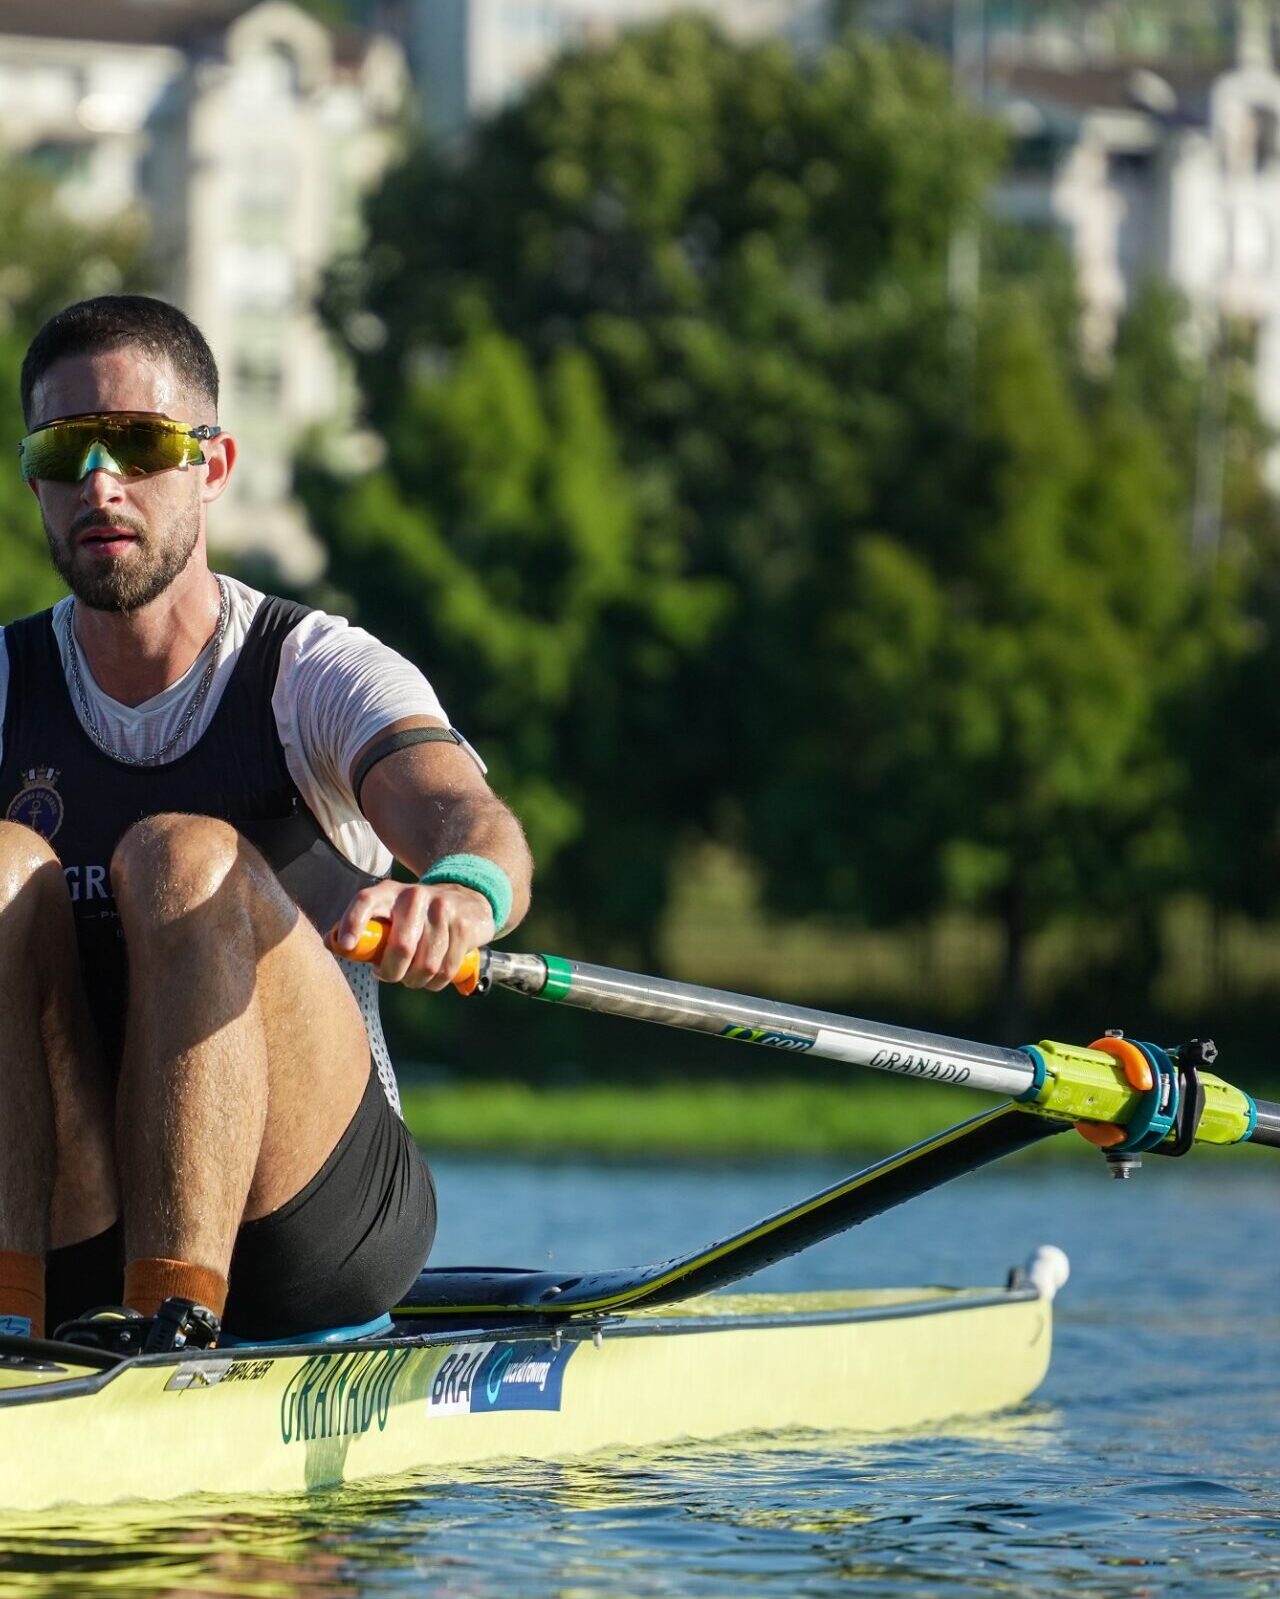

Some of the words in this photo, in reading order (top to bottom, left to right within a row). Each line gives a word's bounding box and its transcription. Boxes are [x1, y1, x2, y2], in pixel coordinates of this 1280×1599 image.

[63, 866, 114, 900] GR
[869, 1049, 971, 1084] GRANADO
[281, 1345, 412, 1444] GRANADO
[432, 1352, 483, 1405] BRA
